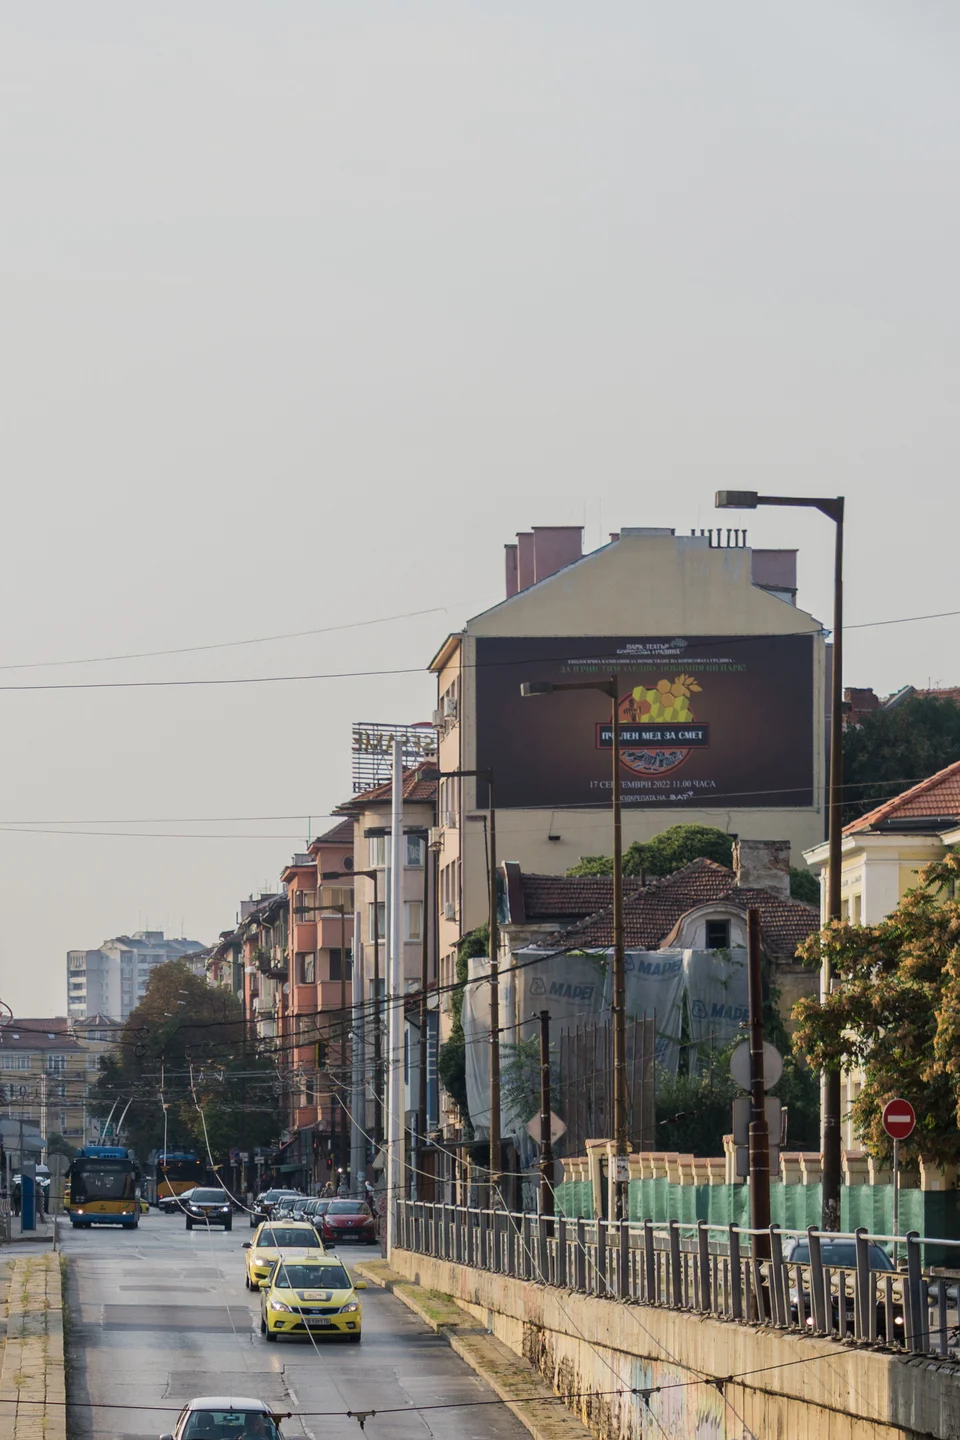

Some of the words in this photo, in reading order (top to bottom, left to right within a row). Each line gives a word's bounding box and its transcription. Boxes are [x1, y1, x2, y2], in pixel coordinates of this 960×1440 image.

[602, 731, 639, 740] ПЧЛЕН
[642, 731, 661, 740] МЕД
[664, 731, 677, 740] ЗА
[678, 731, 704, 740] СМЕТ
[653, 780, 671, 788] 2022
[673, 780, 692, 788] 11.00
[693, 780, 716, 788] ЧАСА
[638, 960, 683, 976] MAPEI
[549, 981, 596, 1000] MAPEI
[711, 1002, 750, 1021] MAPE
